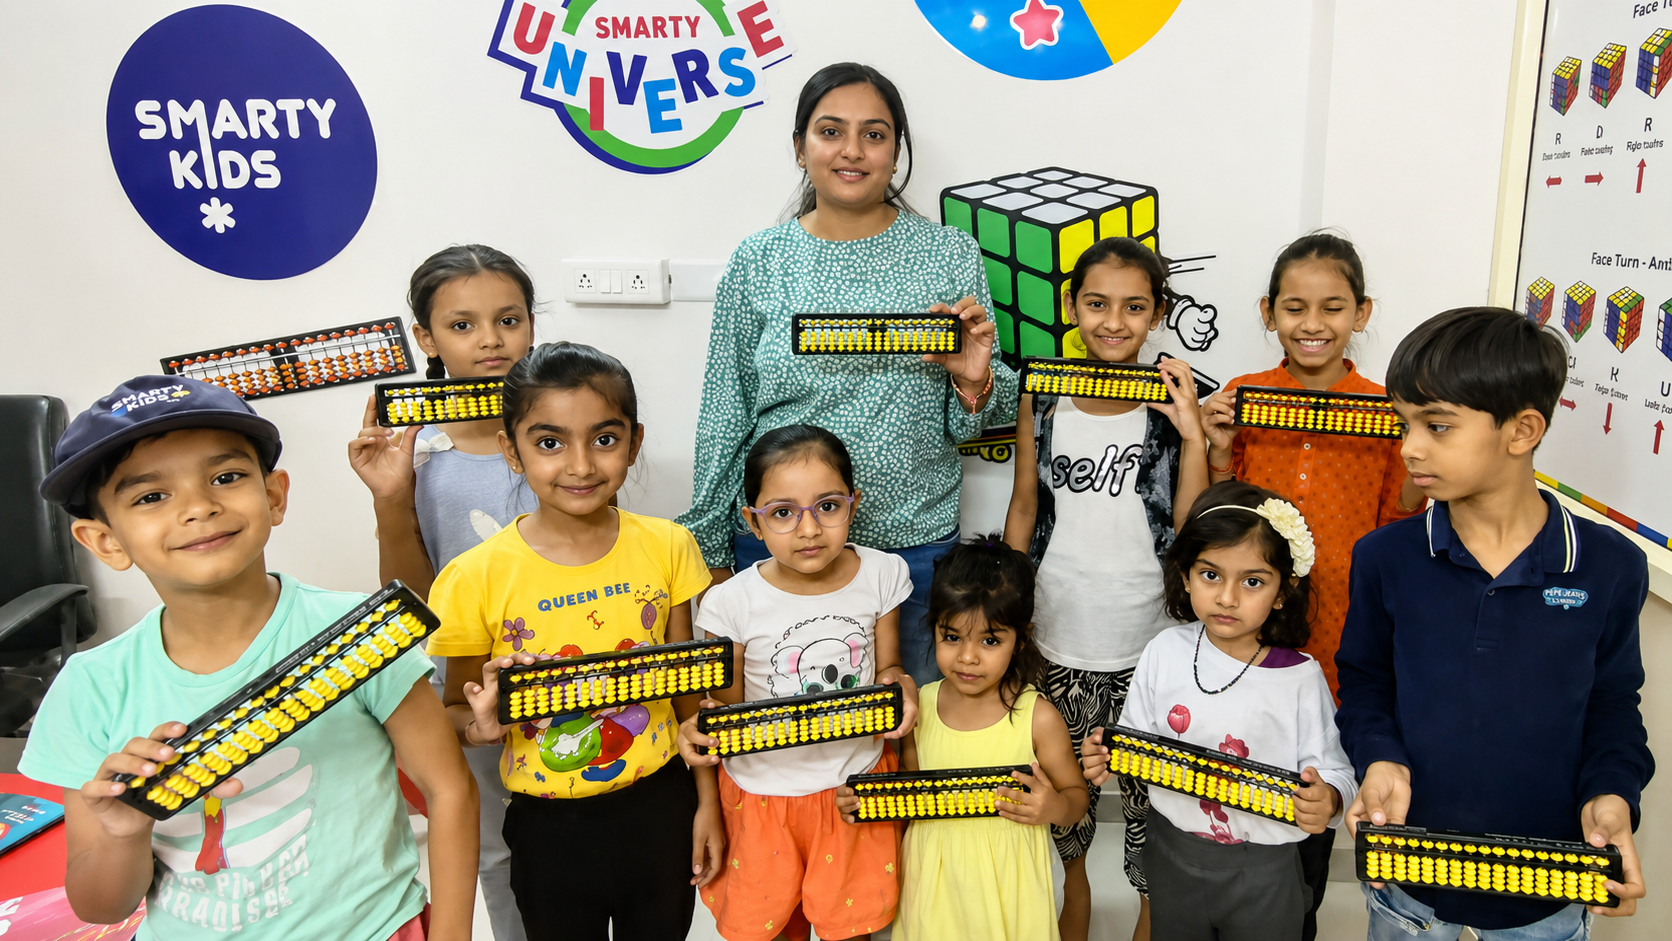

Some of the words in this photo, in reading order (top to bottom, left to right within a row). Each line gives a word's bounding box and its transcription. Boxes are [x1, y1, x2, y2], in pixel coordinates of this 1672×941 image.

[1633, 1, 1658, 19] Face
[595, 16, 700, 39] SMARTY
[513, 0, 784, 134] UNIVERSE
[135, 98, 336, 140] SMARTY
[1644, 117, 1653, 132] R
[1555, 133, 1561, 145] R
[1596, 125, 1603, 139] D
[169, 150, 281, 189] KIDS
[1591, 252, 1612, 266] Face
[1615, 254, 1639, 268] Turn
[111, 384, 183, 412] SMARTY
[126, 394, 169, 412] KIDS
[1052, 444, 1143, 497] self
[538, 589, 598, 612] QUEEN
[604, 583, 631, 597] BEE
